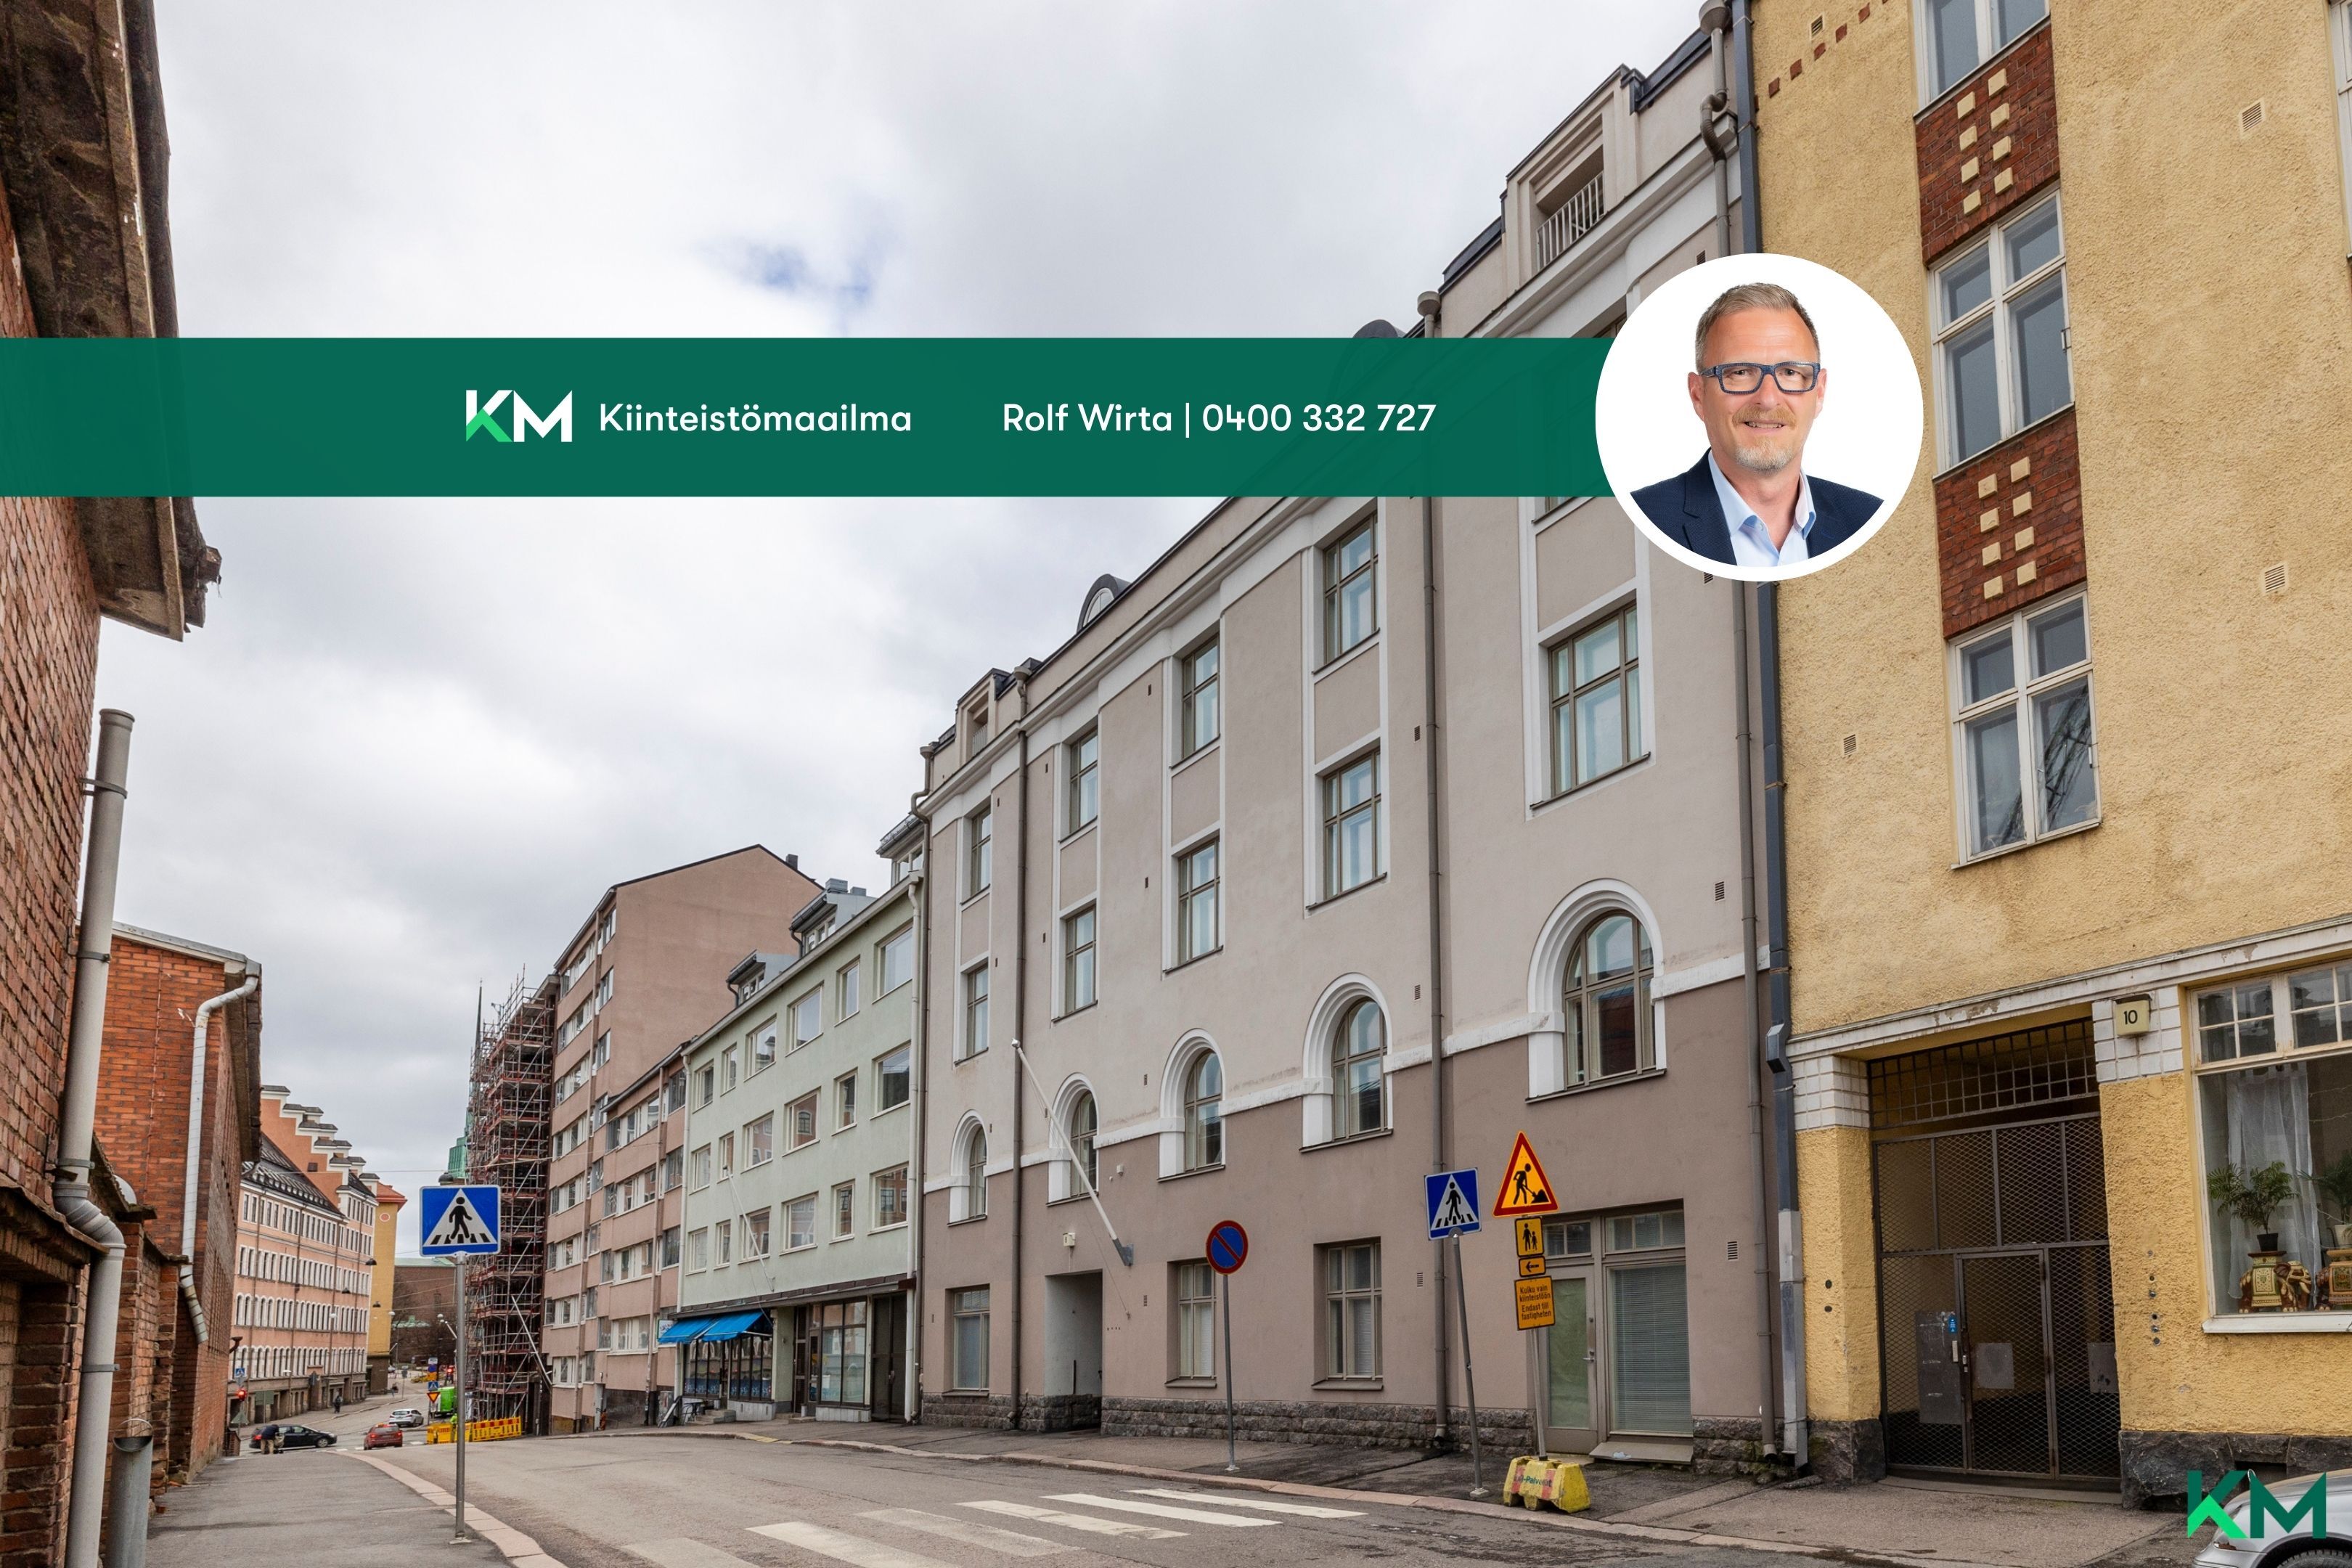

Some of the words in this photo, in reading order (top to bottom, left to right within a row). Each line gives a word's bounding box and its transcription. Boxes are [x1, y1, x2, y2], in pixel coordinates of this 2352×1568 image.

[2123, 1010, 2138, 1025] 10
[1522, 1303, 1540, 1312] Endast
[1522, 1310, 1551, 1320] fastigheten
